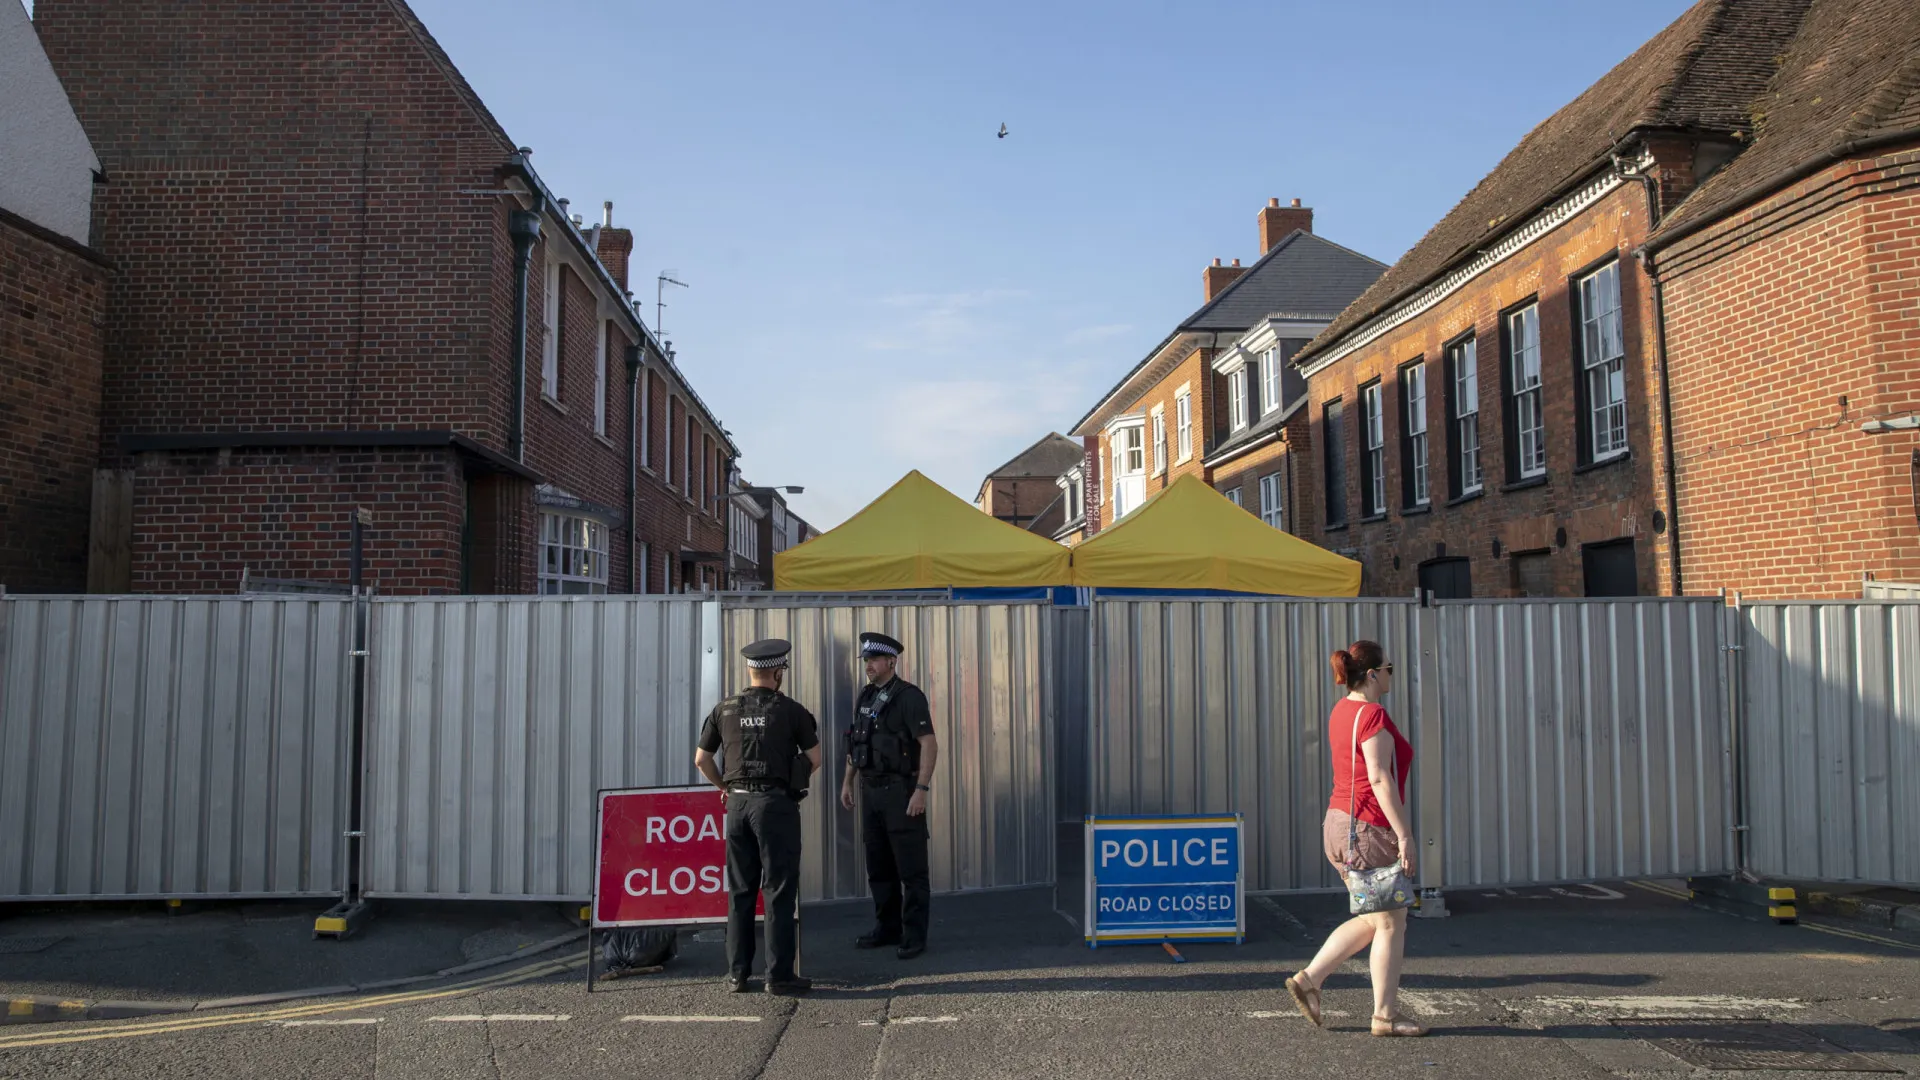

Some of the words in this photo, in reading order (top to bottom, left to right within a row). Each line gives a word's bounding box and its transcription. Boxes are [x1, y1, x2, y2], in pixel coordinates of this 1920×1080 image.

[740, 716, 766, 727] POLICE
[645, 814, 728, 844] ROA
[1101, 838, 1229, 868] POLICE
[624, 865, 729, 897] CLOS
[1100, 896, 1151, 912] ROAD
[1158, 895, 1231, 912] CLOSED
